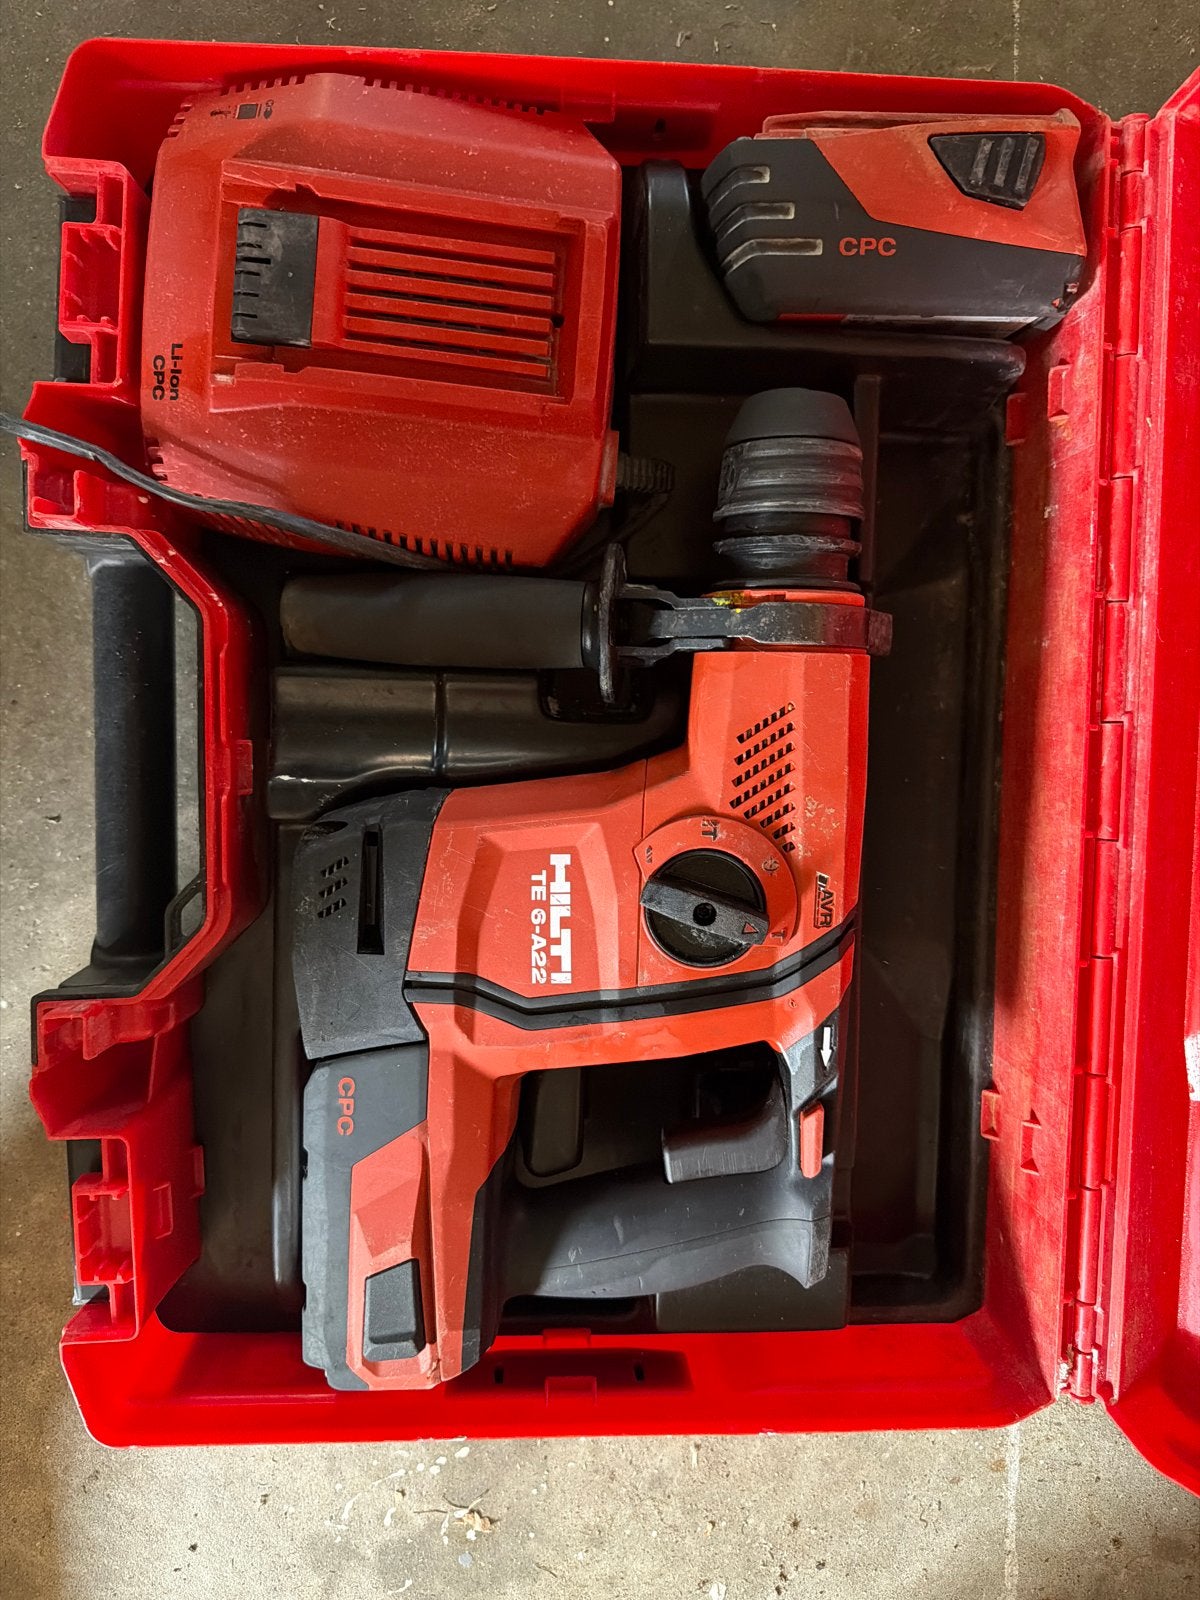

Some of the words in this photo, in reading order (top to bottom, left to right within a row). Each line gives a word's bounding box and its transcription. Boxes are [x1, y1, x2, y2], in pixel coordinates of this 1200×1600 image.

[839, 237, 897, 257] CPC
[152, 354, 165, 401] CPC
[170, 343, 183, 401] Li-Ion
[531, 869, 547, 901] TE
[819, 889, 835, 926] AVR
[549, 853, 571, 985] HILTI
[531, 908, 547, 985] 6-A22
[337, 1076, 355, 1136] CPC
